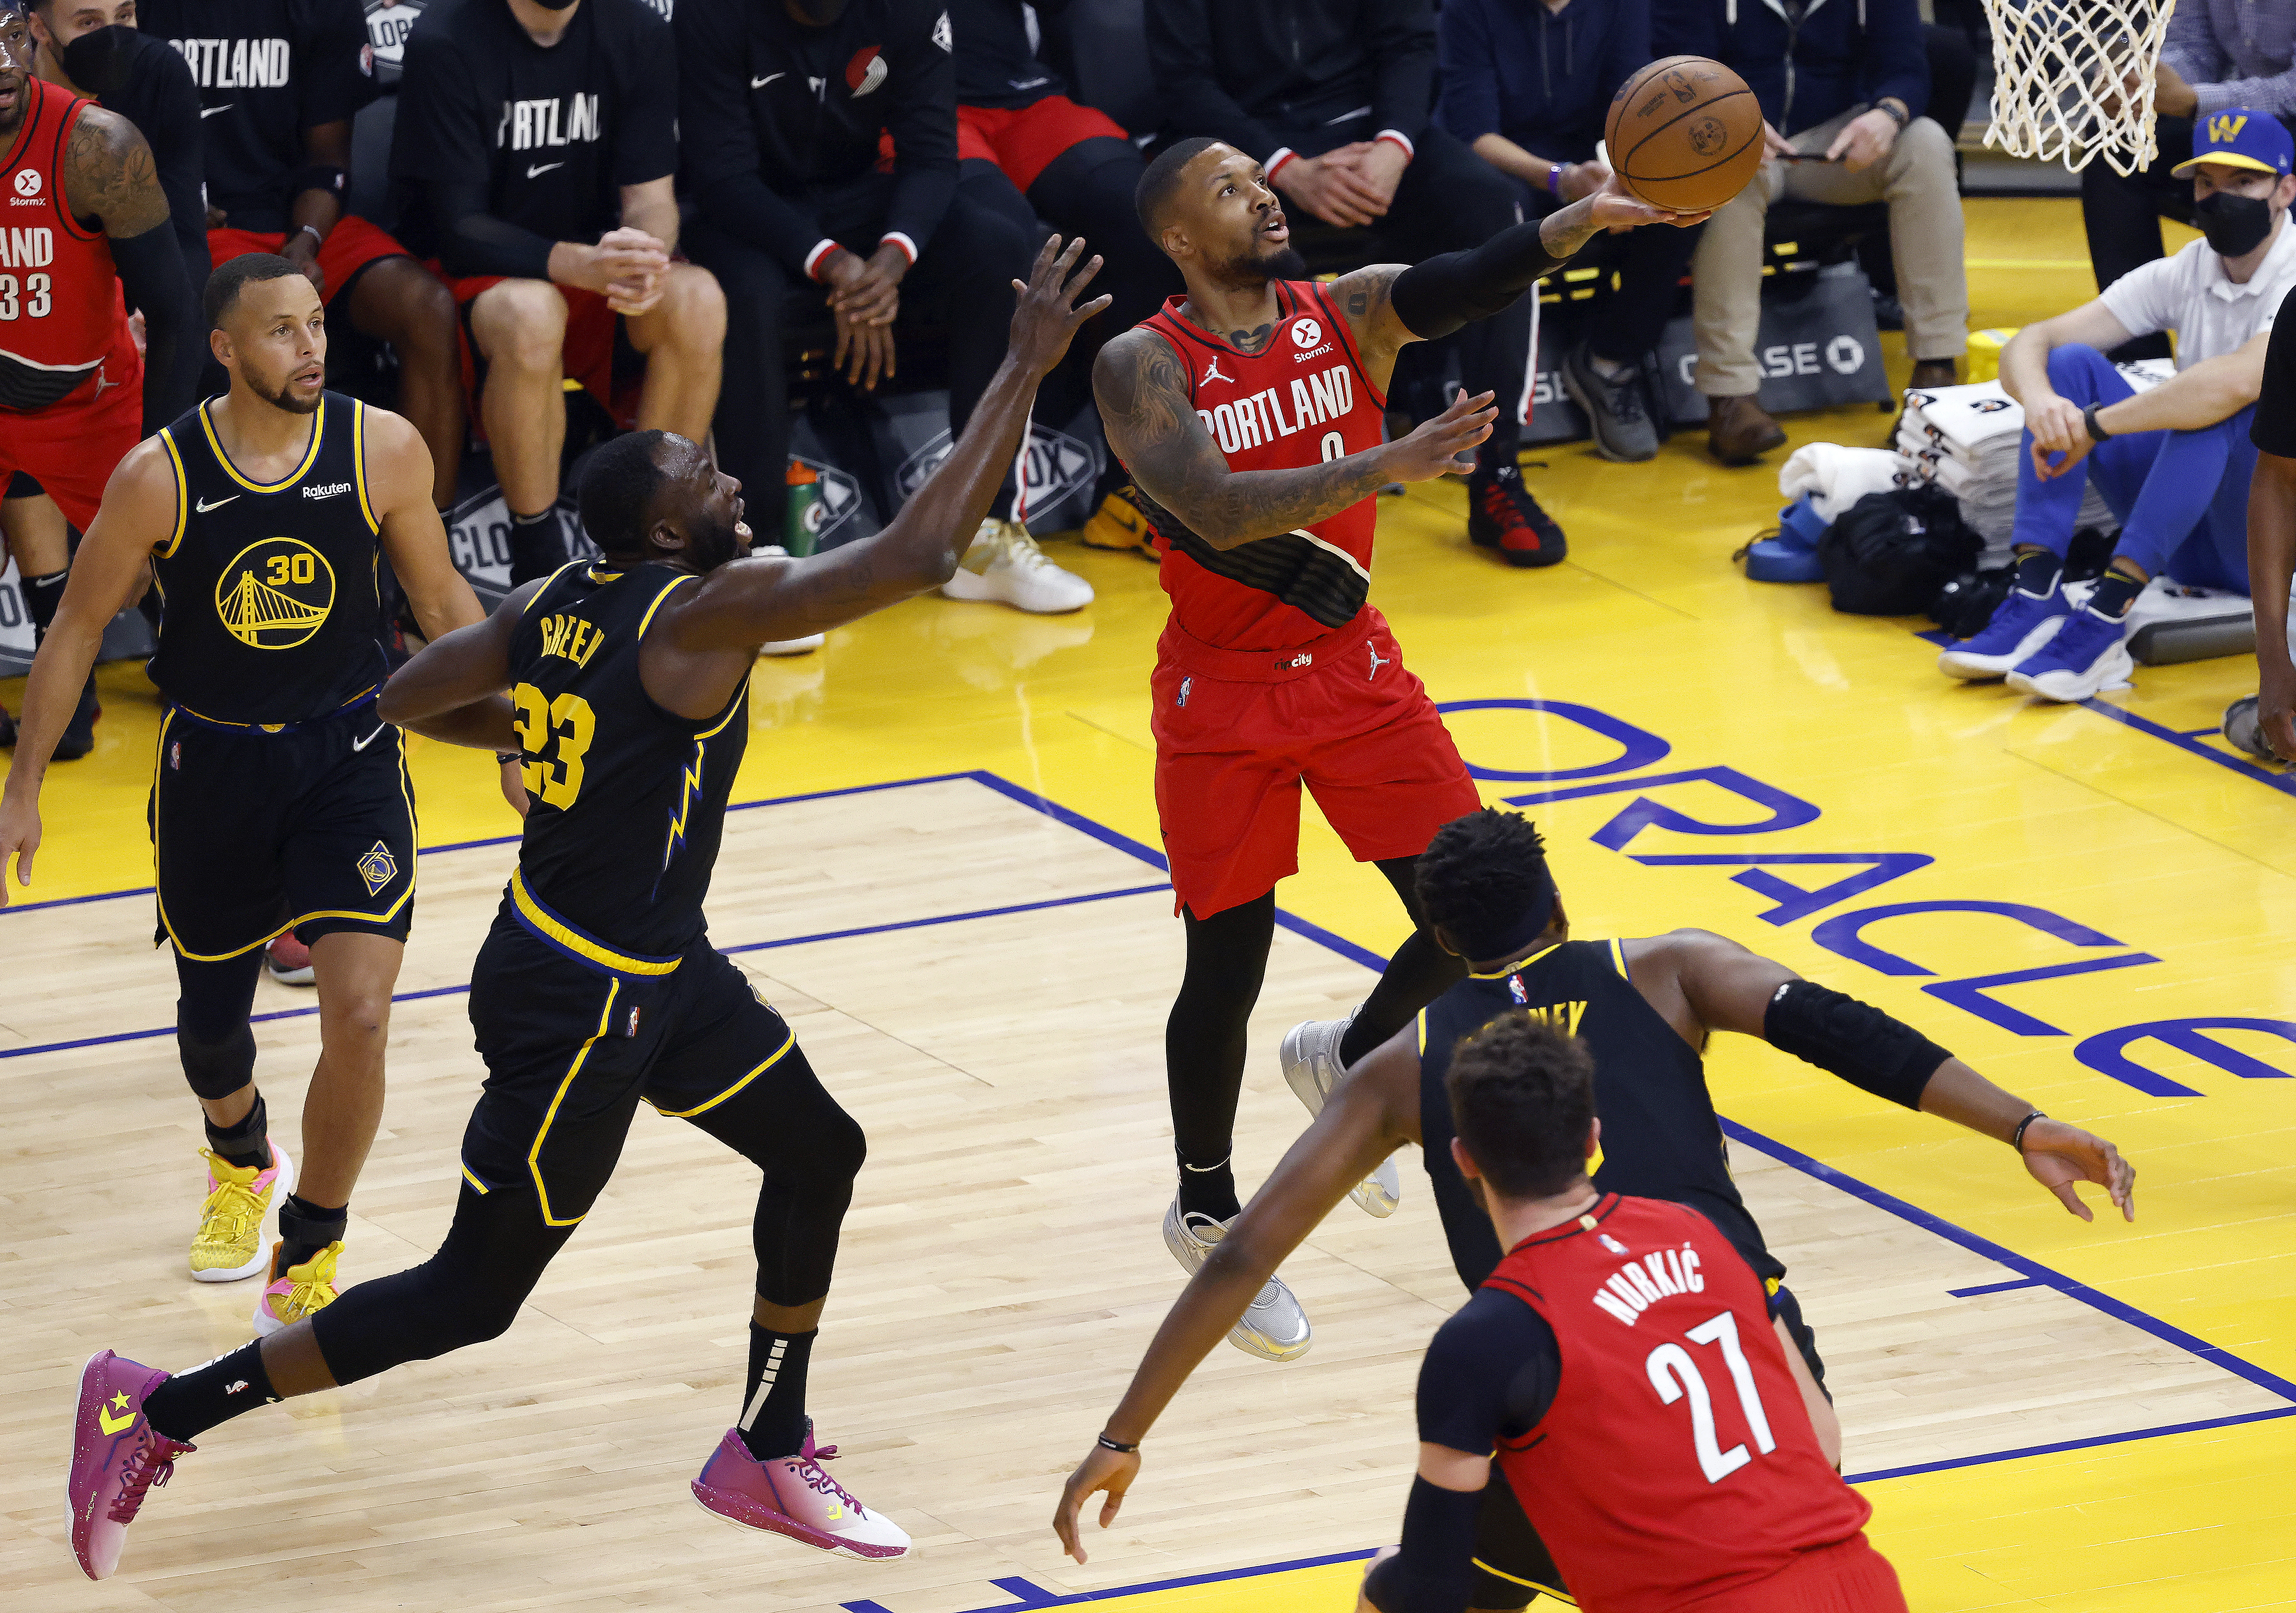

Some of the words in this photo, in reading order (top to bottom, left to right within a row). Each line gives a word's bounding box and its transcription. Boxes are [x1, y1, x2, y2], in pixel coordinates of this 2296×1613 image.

[168, 39, 290, 88] RTLAND
[2209, 115, 2248, 143] W
[10, 197, 46, 206] StormX
[0, 272, 51, 320] 33
[1294, 342, 1334, 363] StormX
[303, 483, 351, 498] Rakuten
[452, 516, 593, 568] CLOX
[267, 553, 315, 586] 30
[540, 614, 605, 669] GREEN
[1436, 697, 2296, 1098] ORACLE
[1592, 1241, 1705, 1327] NURKIĆ
[1646, 1310, 1777, 1484] 27
